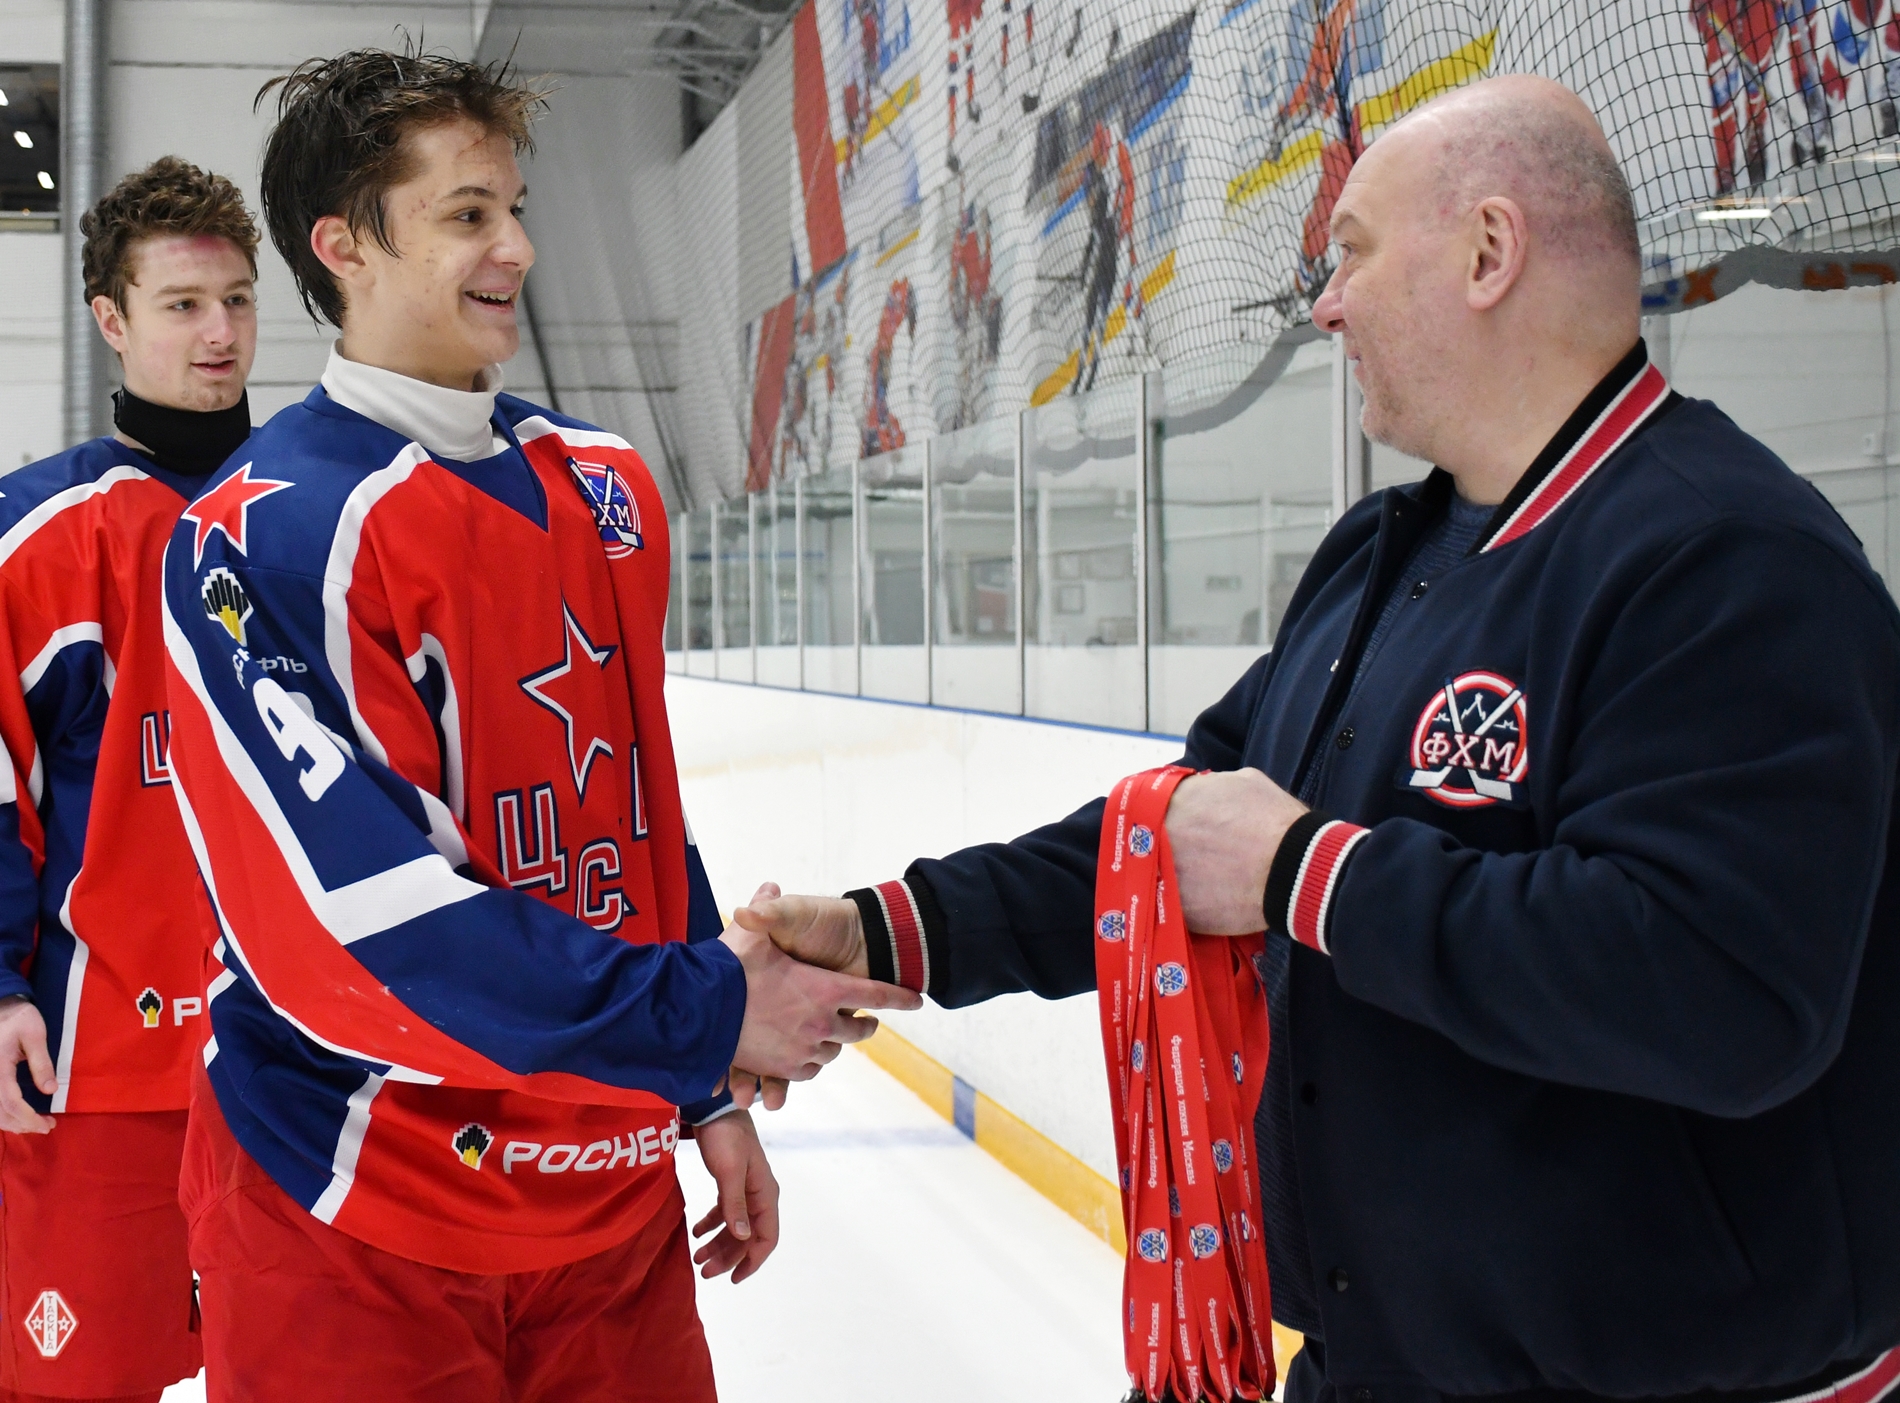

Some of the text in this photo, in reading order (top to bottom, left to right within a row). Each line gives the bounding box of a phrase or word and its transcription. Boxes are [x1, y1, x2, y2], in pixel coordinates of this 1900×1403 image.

[1422, 731, 1516, 774] ФХМ
[1111, 814, 1125, 872] Федерация
[1113, 980, 1121, 1022] Москвы
[1171, 1035, 1196, 1186] Федерация хоккея Москвы
[503, 1106, 681, 1174] РОСНЕФ
[1148, 1128, 1158, 1188] Федерация
[1173, 1258, 1186, 1319] Федерация
[46, 1295, 55, 1350] TACKLA
[1148, 1302, 1160, 1347] Москвы
[1179, 1323, 1192, 1361] хоккея
